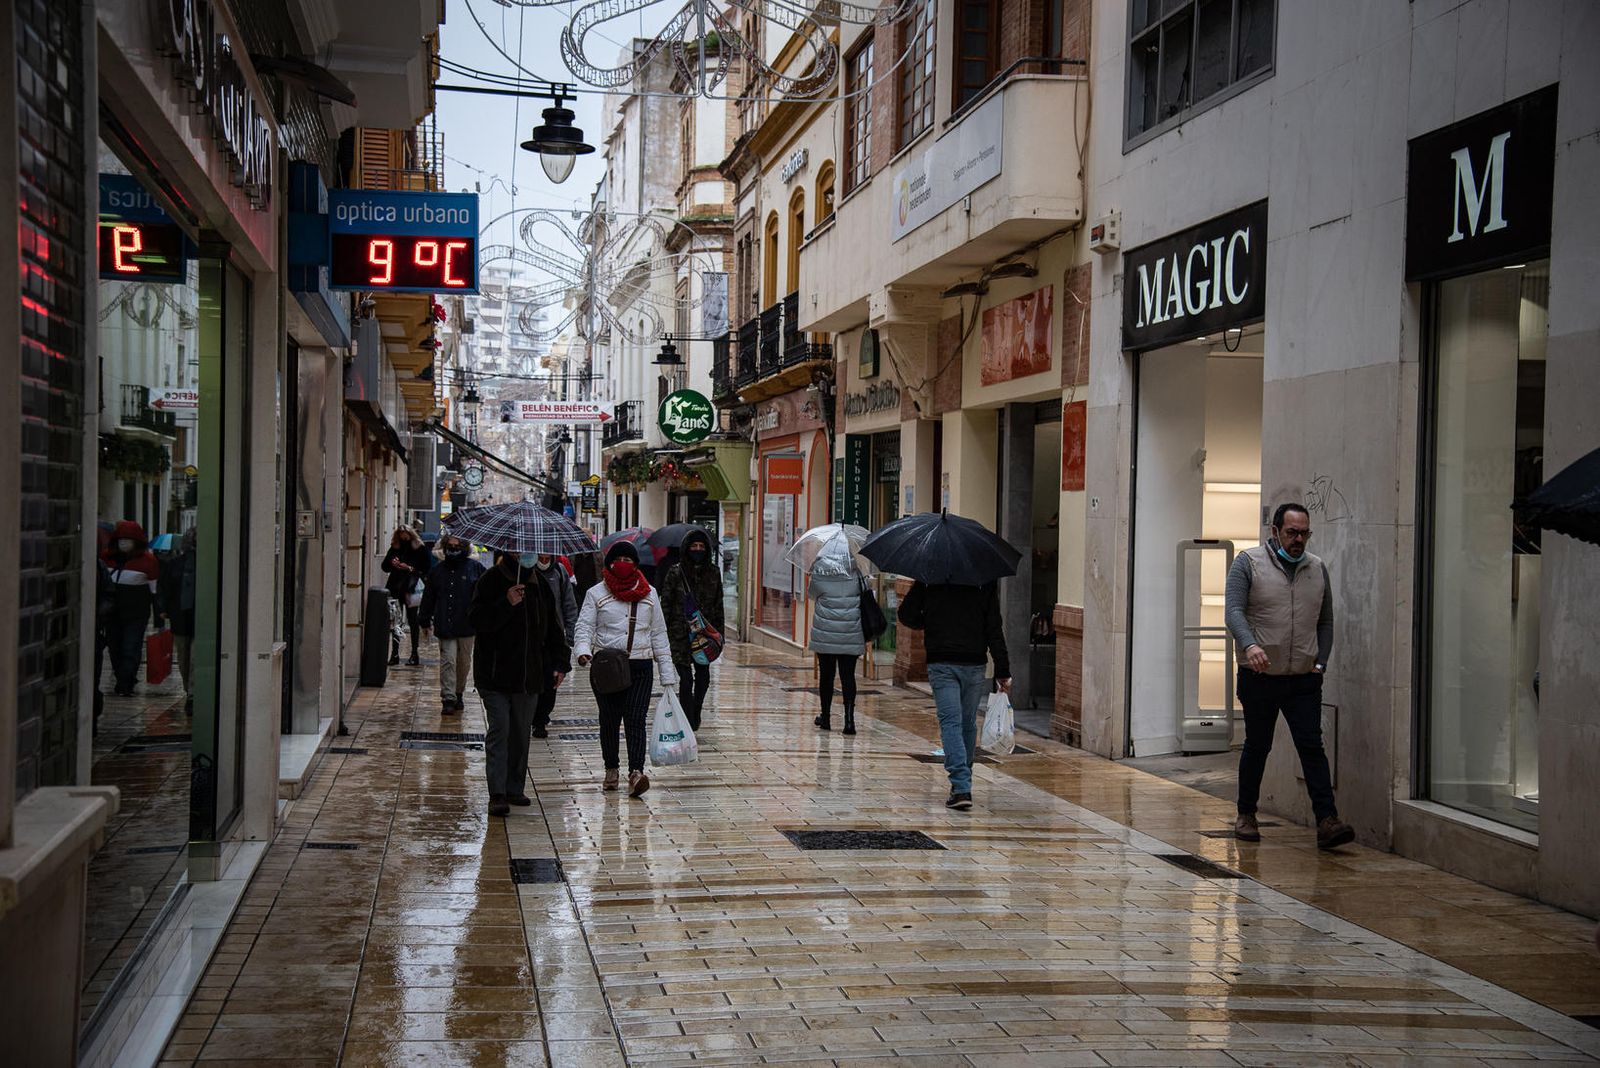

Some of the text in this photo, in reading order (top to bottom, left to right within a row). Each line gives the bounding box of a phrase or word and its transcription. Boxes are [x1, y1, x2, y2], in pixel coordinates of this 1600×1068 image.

[404, 202, 470, 224] urbano
[1448, 131, 1511, 243] M
[369, 240, 393, 284] 9
[1136, 227, 1251, 328] MAGIC
[522, 403, 551, 412] BELÉN
[853, 440, 862, 525] Herbolario
